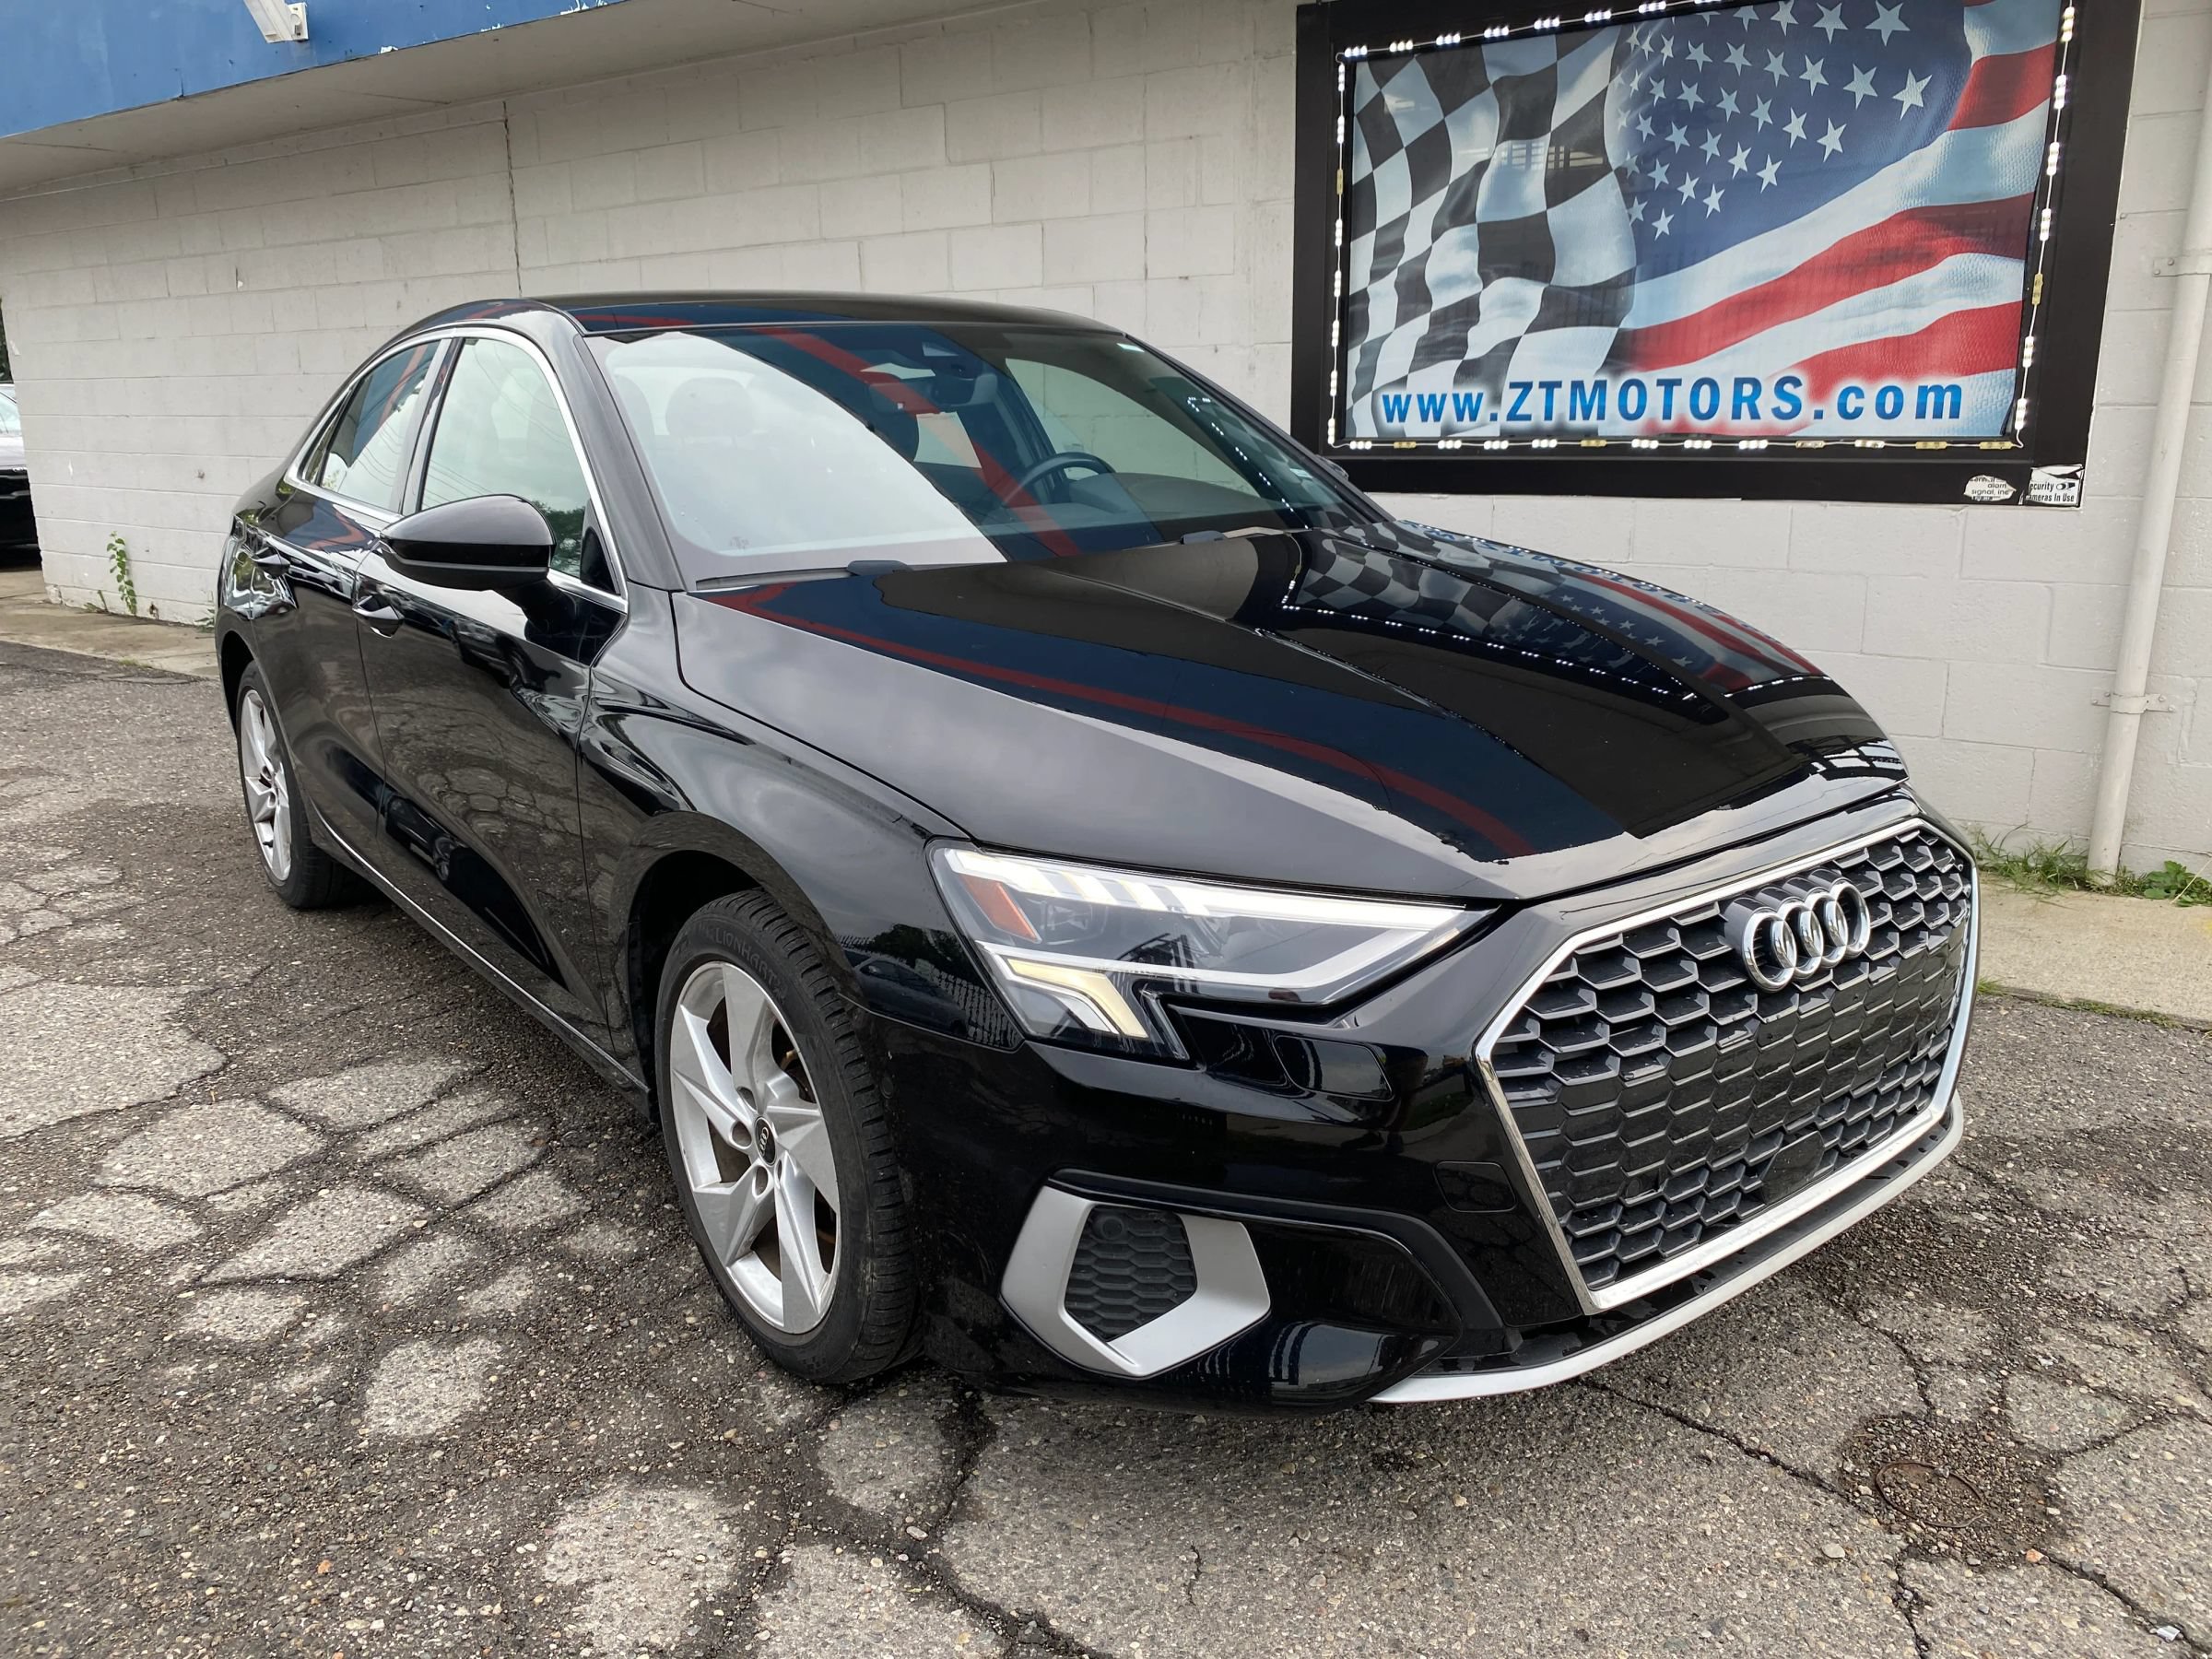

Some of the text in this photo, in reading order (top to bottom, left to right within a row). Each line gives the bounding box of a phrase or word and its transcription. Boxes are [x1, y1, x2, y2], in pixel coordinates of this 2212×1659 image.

[1382, 376, 1962, 423] www.ZTMOTORS.com
[2030, 482, 2054, 492] ecurity
[2063, 493, 2075, 502] Use
